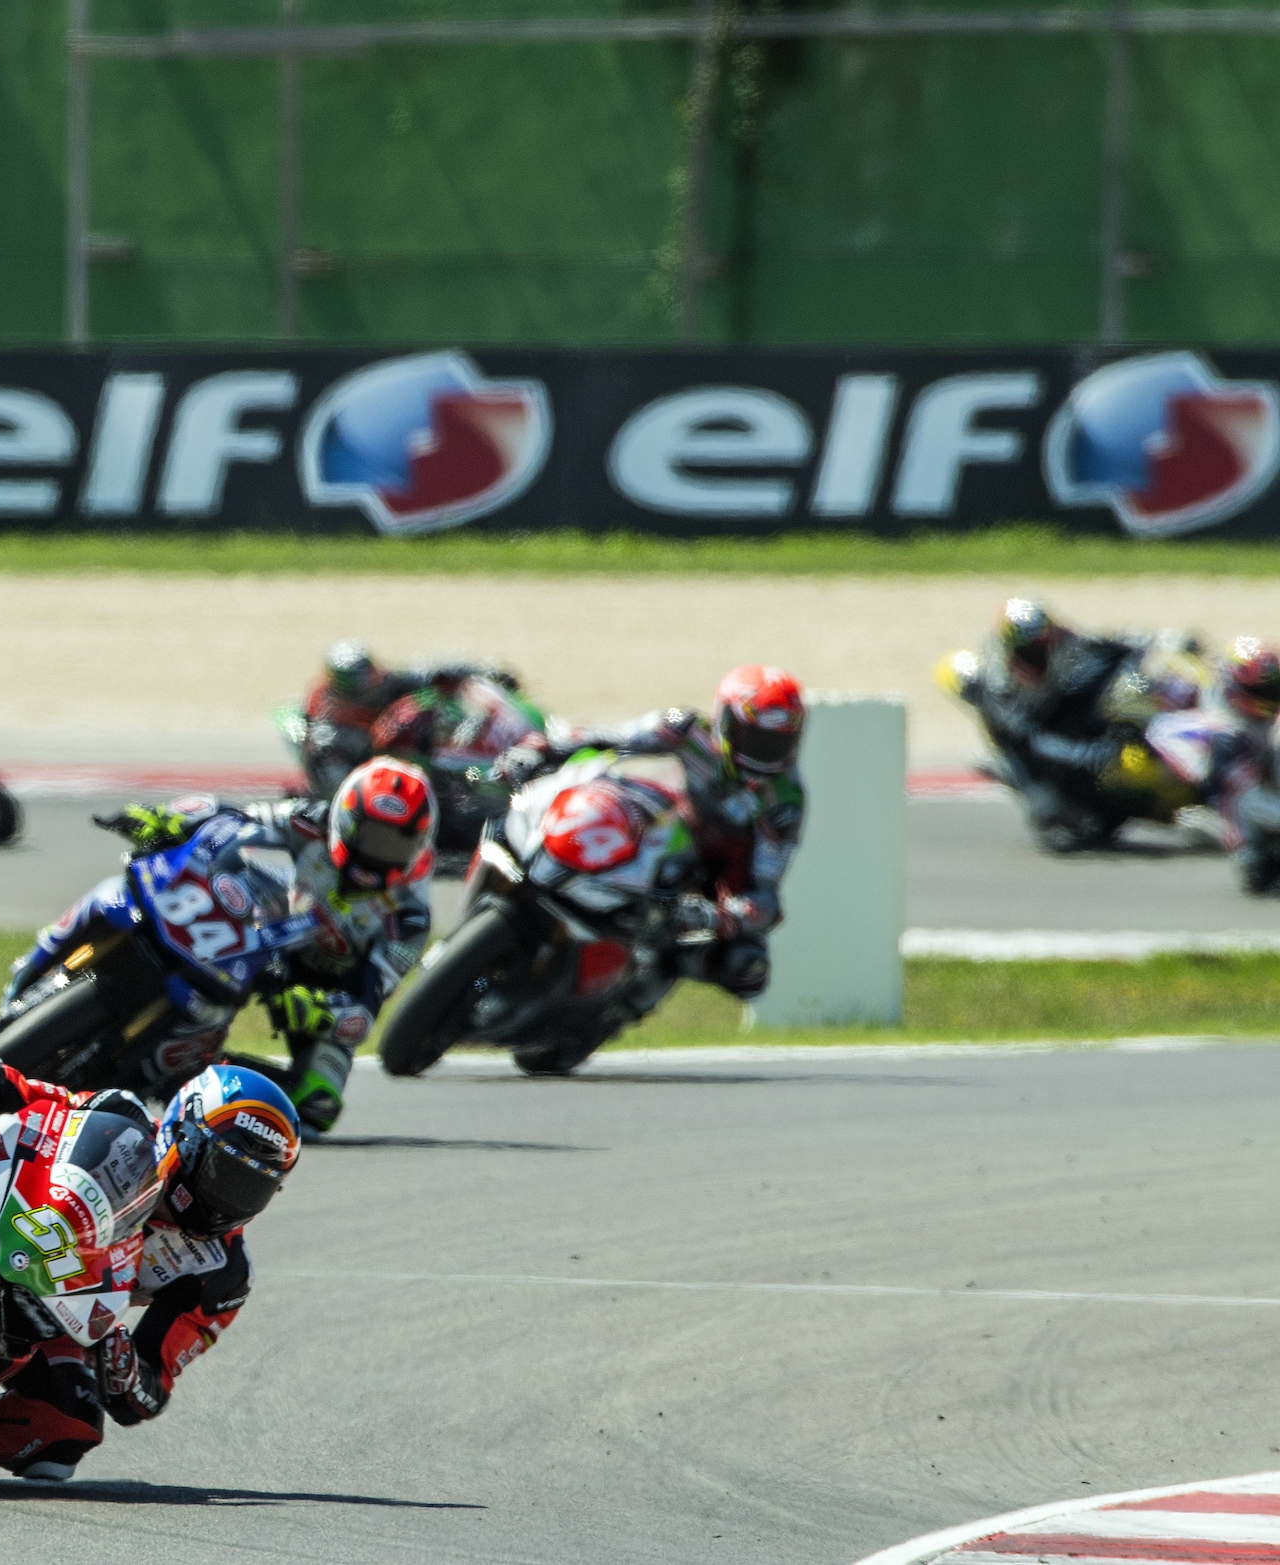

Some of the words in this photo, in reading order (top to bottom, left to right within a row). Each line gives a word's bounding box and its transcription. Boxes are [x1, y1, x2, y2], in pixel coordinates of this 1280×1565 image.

[152, 882, 241, 962] 84
[11, 1205, 87, 1282] 51
[152, 1265, 170, 1283] GLS
